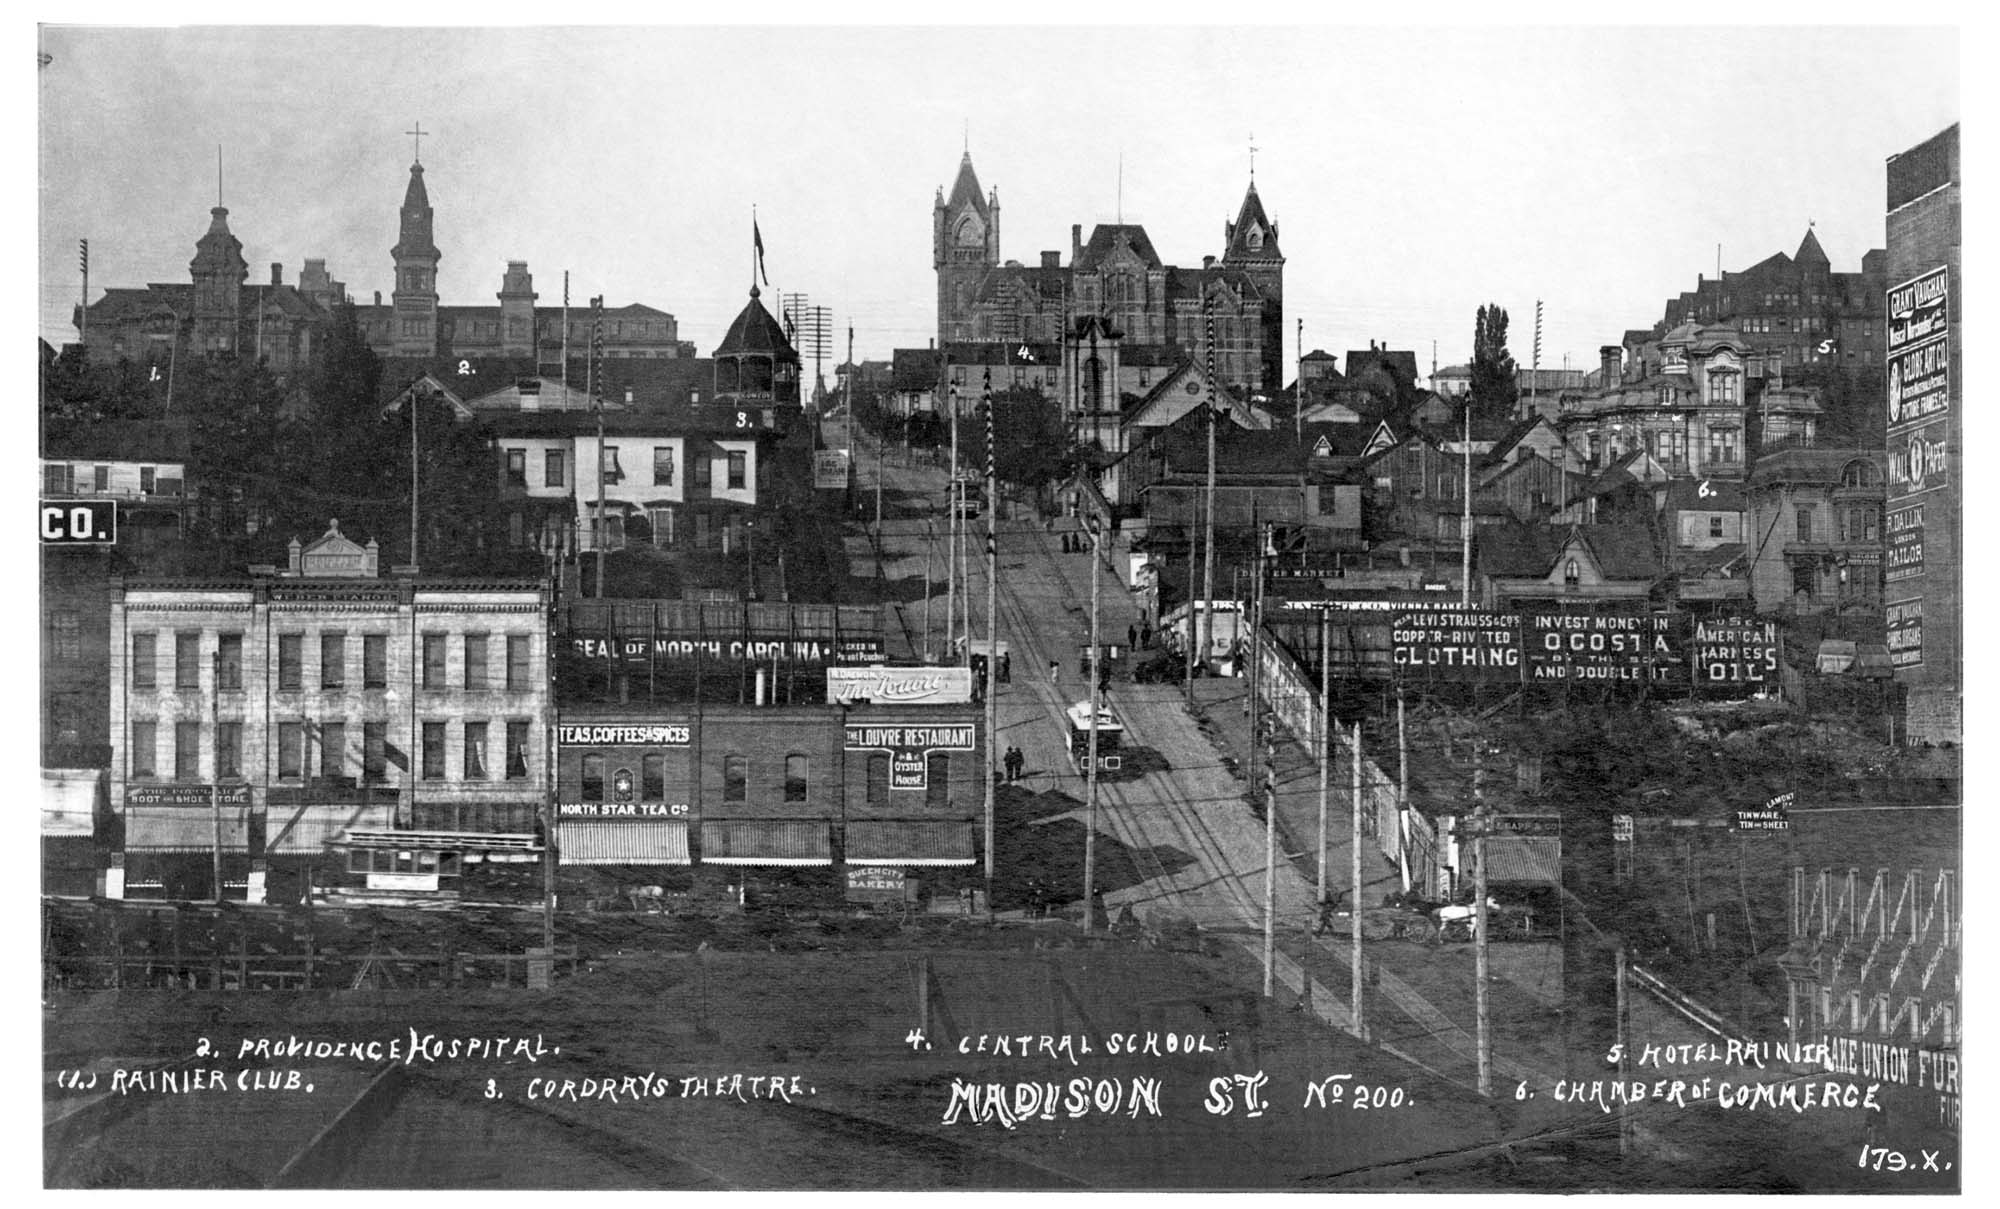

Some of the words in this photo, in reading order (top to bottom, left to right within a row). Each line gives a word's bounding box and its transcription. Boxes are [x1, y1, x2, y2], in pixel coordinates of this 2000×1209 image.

[1890, 287, 1914, 319] GRANT
[1903, 349, 1923, 382] GLOBE
[1924, 345, 1936, 375] ART
[1888, 451, 1908, 486] WALL
[42, 507, 106, 539] CO.
[1889, 544, 1922, 567] TAILOR
[1391, 602, 1429, 610] VIENNA
[1434, 602, 1480, 610] BAKEY.
[1412, 614, 1438, 626] LEVI
[1439, 614, 1493, 627] STRAUSS
[1535, 615, 1590, 629] INVEST
[1653, 617, 1669, 630] IN
[625, 643, 647, 655] OF
[655, 640, 721, 660] NORTH
[1393, 646, 1519, 666] CLOTHING
[1534, 665, 1566, 678] AND
[1652, 666, 1669, 680] IT
[1709, 662, 1764, 681] OIL
[652, 725, 690, 743] SPICES
[846, 730, 858, 744] THE
[858, 728, 902, 746] LOUVRE
[904, 728, 972, 746] RESTAURANT
[894, 761, 924, 772] OYSTER
[895, 774, 923, 785] HOUSE
[131, 795, 161, 804] BOOT
[176, 795, 204, 804] SHOE
[560, 803, 598, 815] NORTH
[601, 803, 636, 815] STAR
[641, 803, 668, 815] TEA
[1763, 820, 1789, 829] SHEET
[848, 880, 905, 889] BAKERY
[1862, 1040, 1910, 1086] UNION
